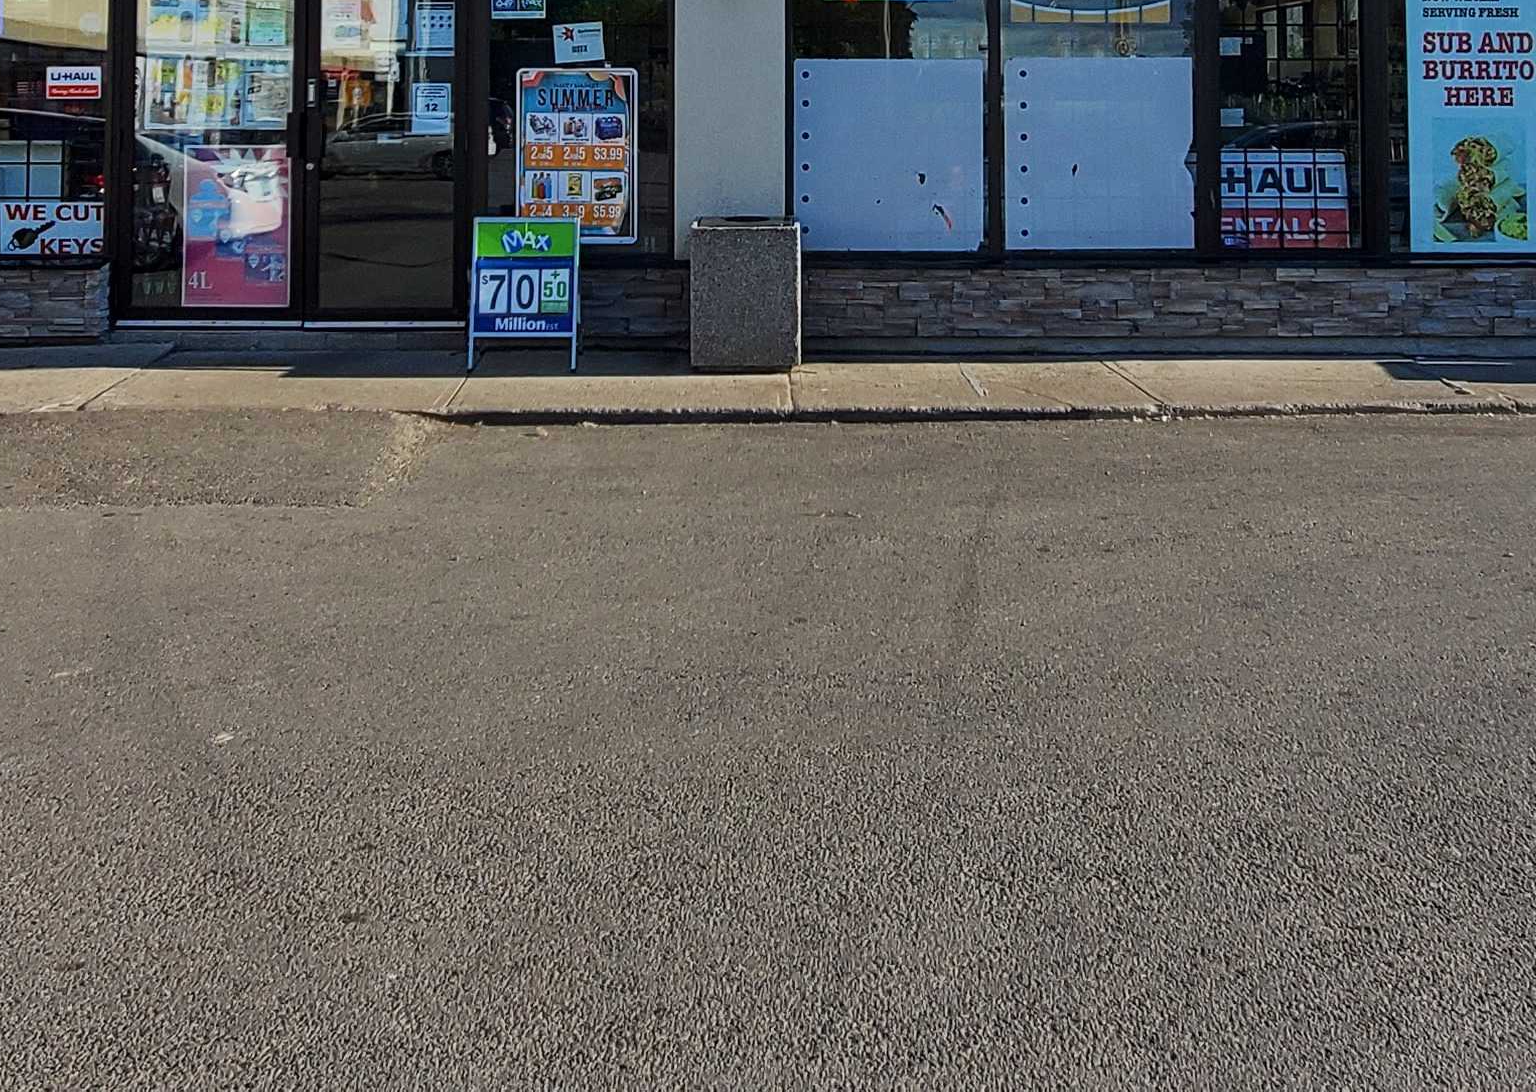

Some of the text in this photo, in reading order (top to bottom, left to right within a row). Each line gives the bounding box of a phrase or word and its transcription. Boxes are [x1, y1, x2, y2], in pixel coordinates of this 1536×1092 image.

[1422, 7, 1520, 18] SERVING FRESH
[1422, 31, 1535, 54] SUB AND
[50, 72, 97, 82] U-HAUL
[1422, 59, 1535, 81] BURRITO
[537, 88, 614, 107] SUMMER
[1443, 86, 1514, 107] HERE
[424, 103, 439, 113] 12
[593, 147, 624, 161] $3.99
[4, 203, 104, 222] WE CUT
[39, 237, 104, 255] KEYS
[502, 229, 551, 253] MAX
[187, 270, 213, 290] 4L
[494, 316, 546, 332] Million
